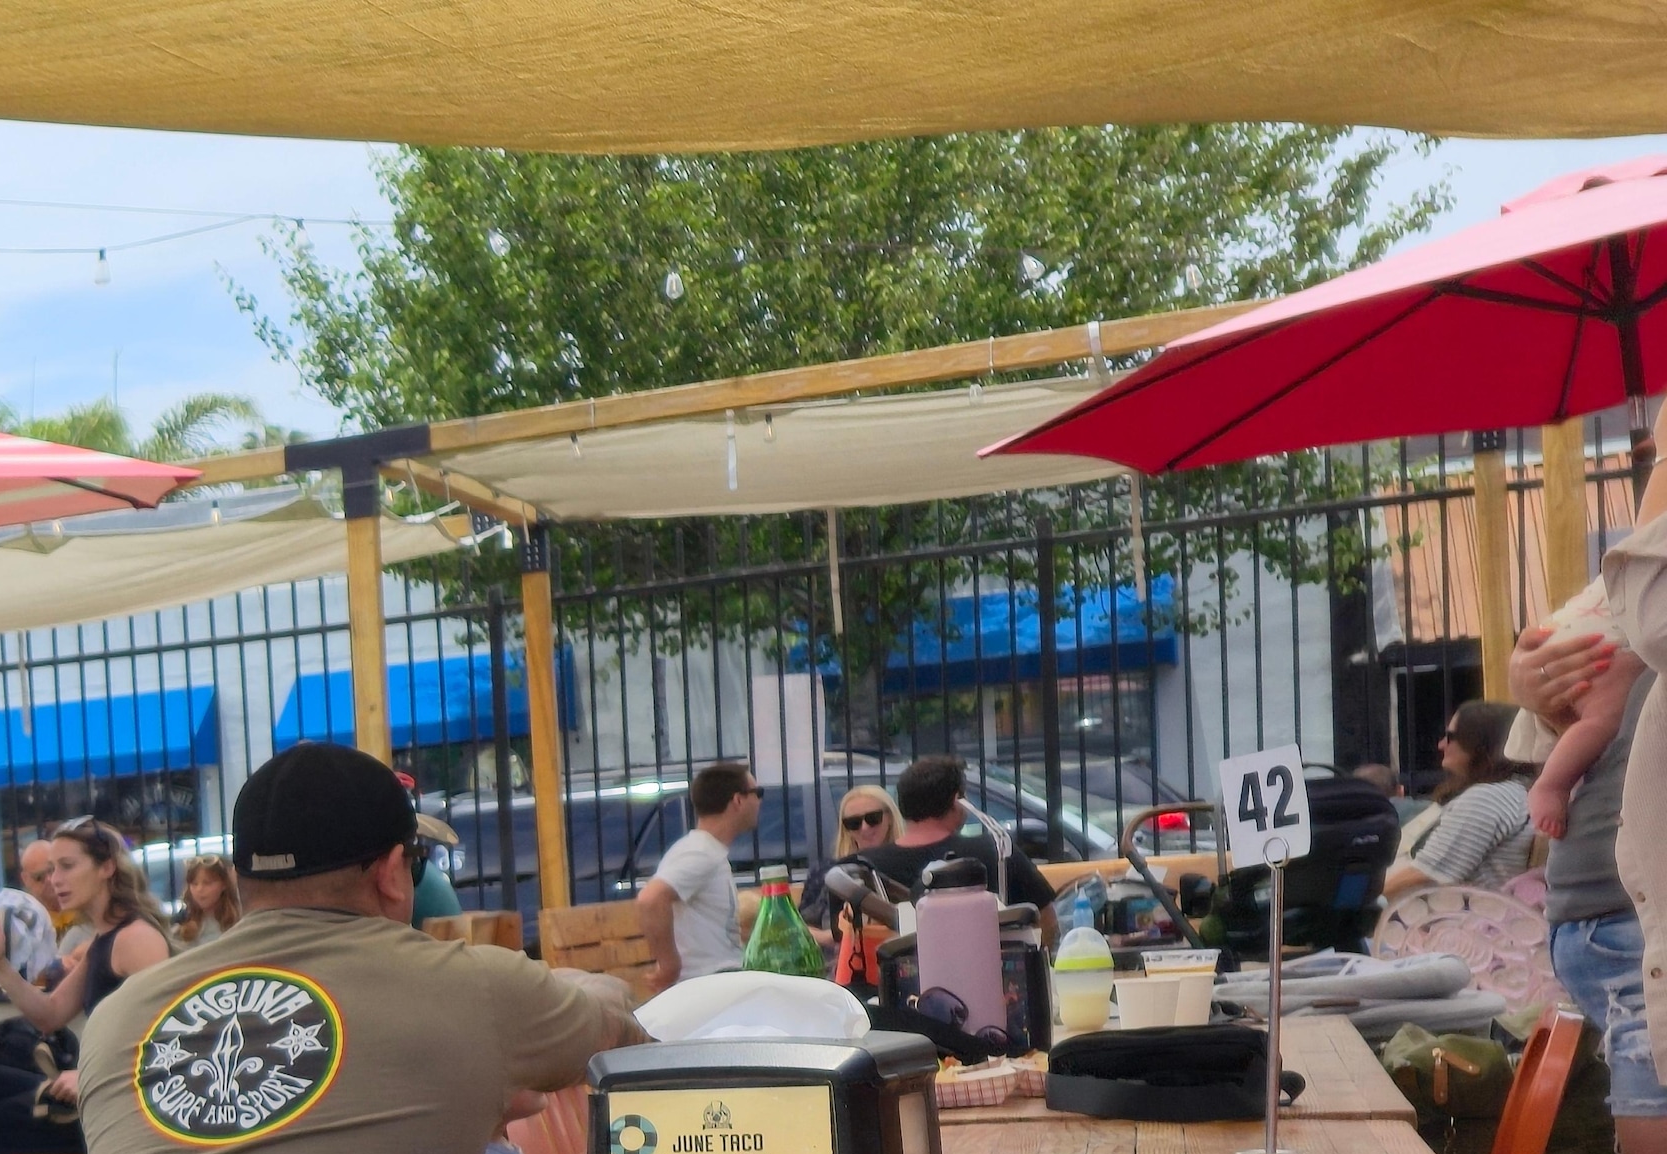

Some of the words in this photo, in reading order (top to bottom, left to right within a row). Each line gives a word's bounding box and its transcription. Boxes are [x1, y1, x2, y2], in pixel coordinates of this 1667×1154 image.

[1238, 764, 1300, 832] 42
[161, 979, 314, 1035] LAGUNA
[151, 1074, 207, 1130] SURF
[203, 1105, 237, 1125] AND
[236, 1064, 314, 1130] SPORT
[672, 1134, 714, 1153] JUNE
[719, 1133, 764, 1152] TACO
